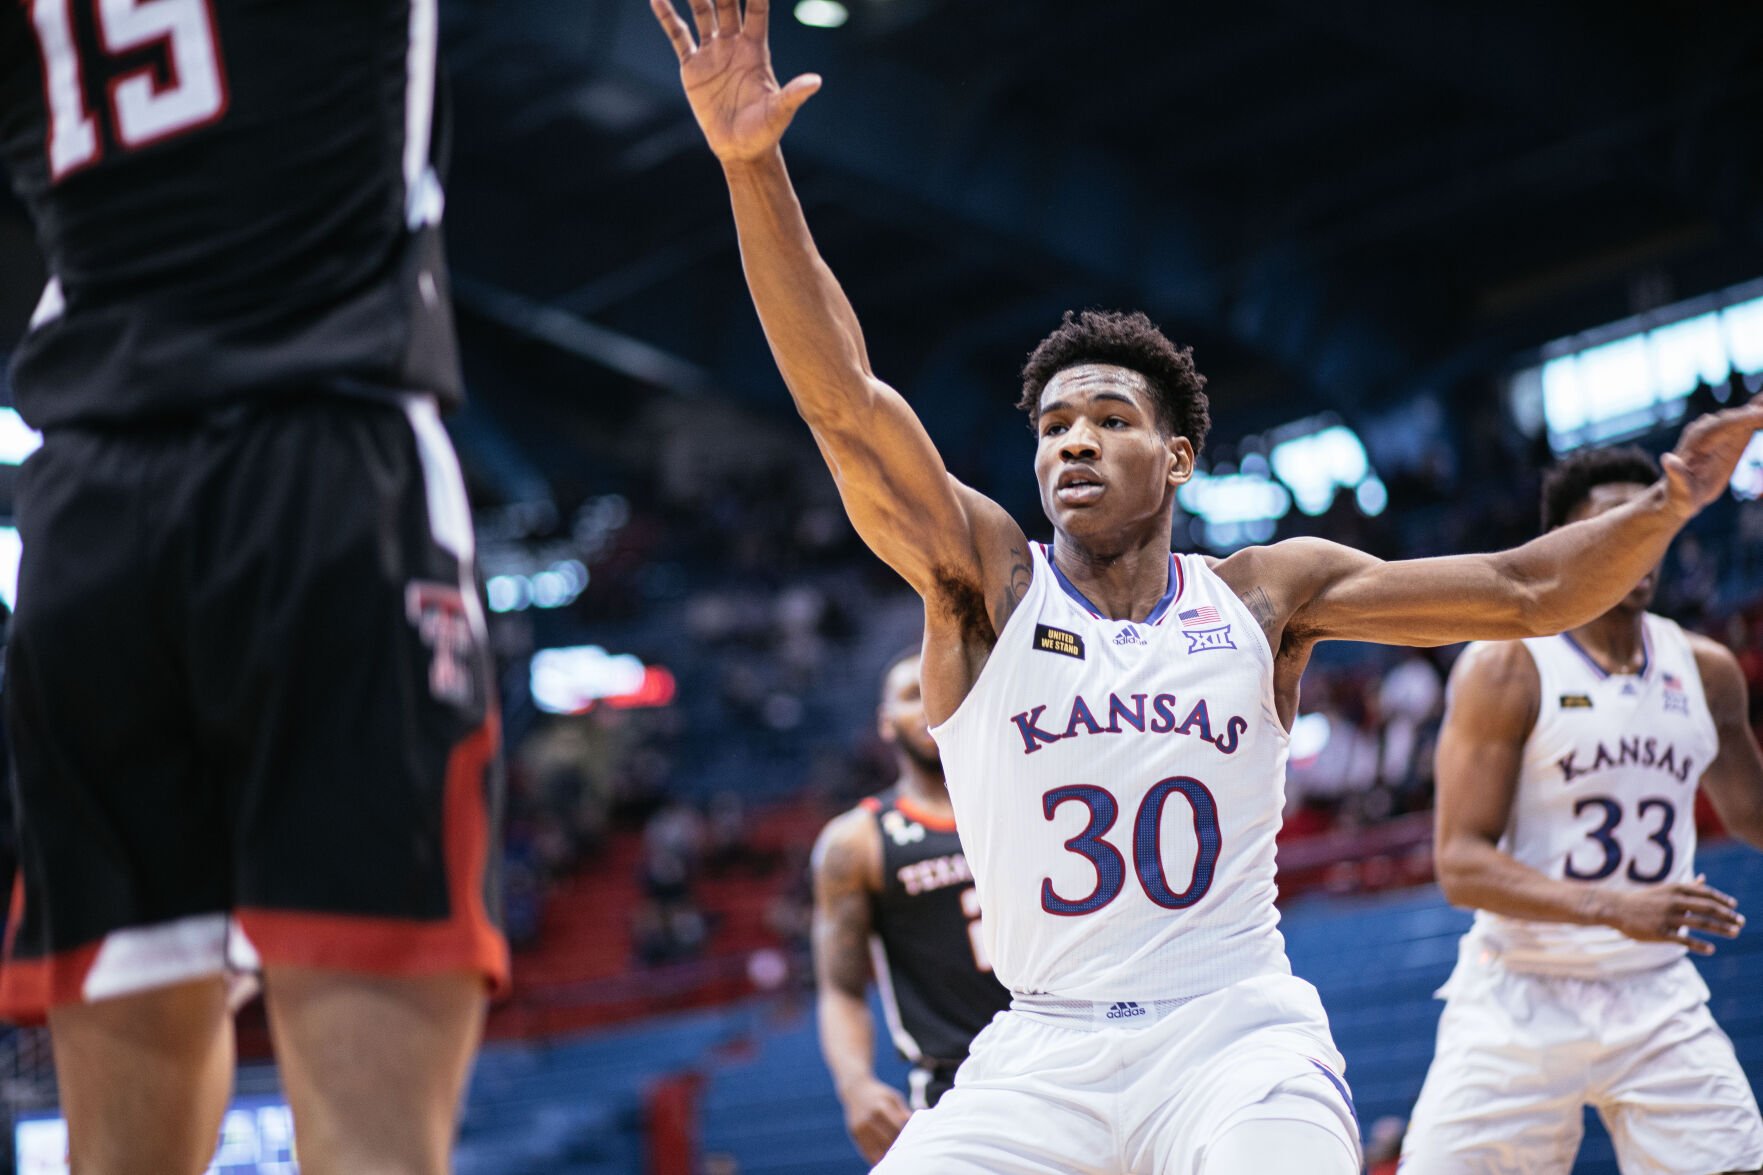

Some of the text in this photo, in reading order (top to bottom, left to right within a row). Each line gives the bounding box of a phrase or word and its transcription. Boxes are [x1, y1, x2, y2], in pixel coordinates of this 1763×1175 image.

[28, 0, 229, 186] 15
[1041, 638, 1079, 656] WE STAND
[1047, 629, 1074, 645] UNITED
[1010, 692, 1248, 755] KANSAS
[1557, 735, 1693, 782] KANSAS
[1041, 775, 1222, 917] 30
[1563, 796, 1677, 885] 33
[1106, 1007, 1146, 1019] adidas
